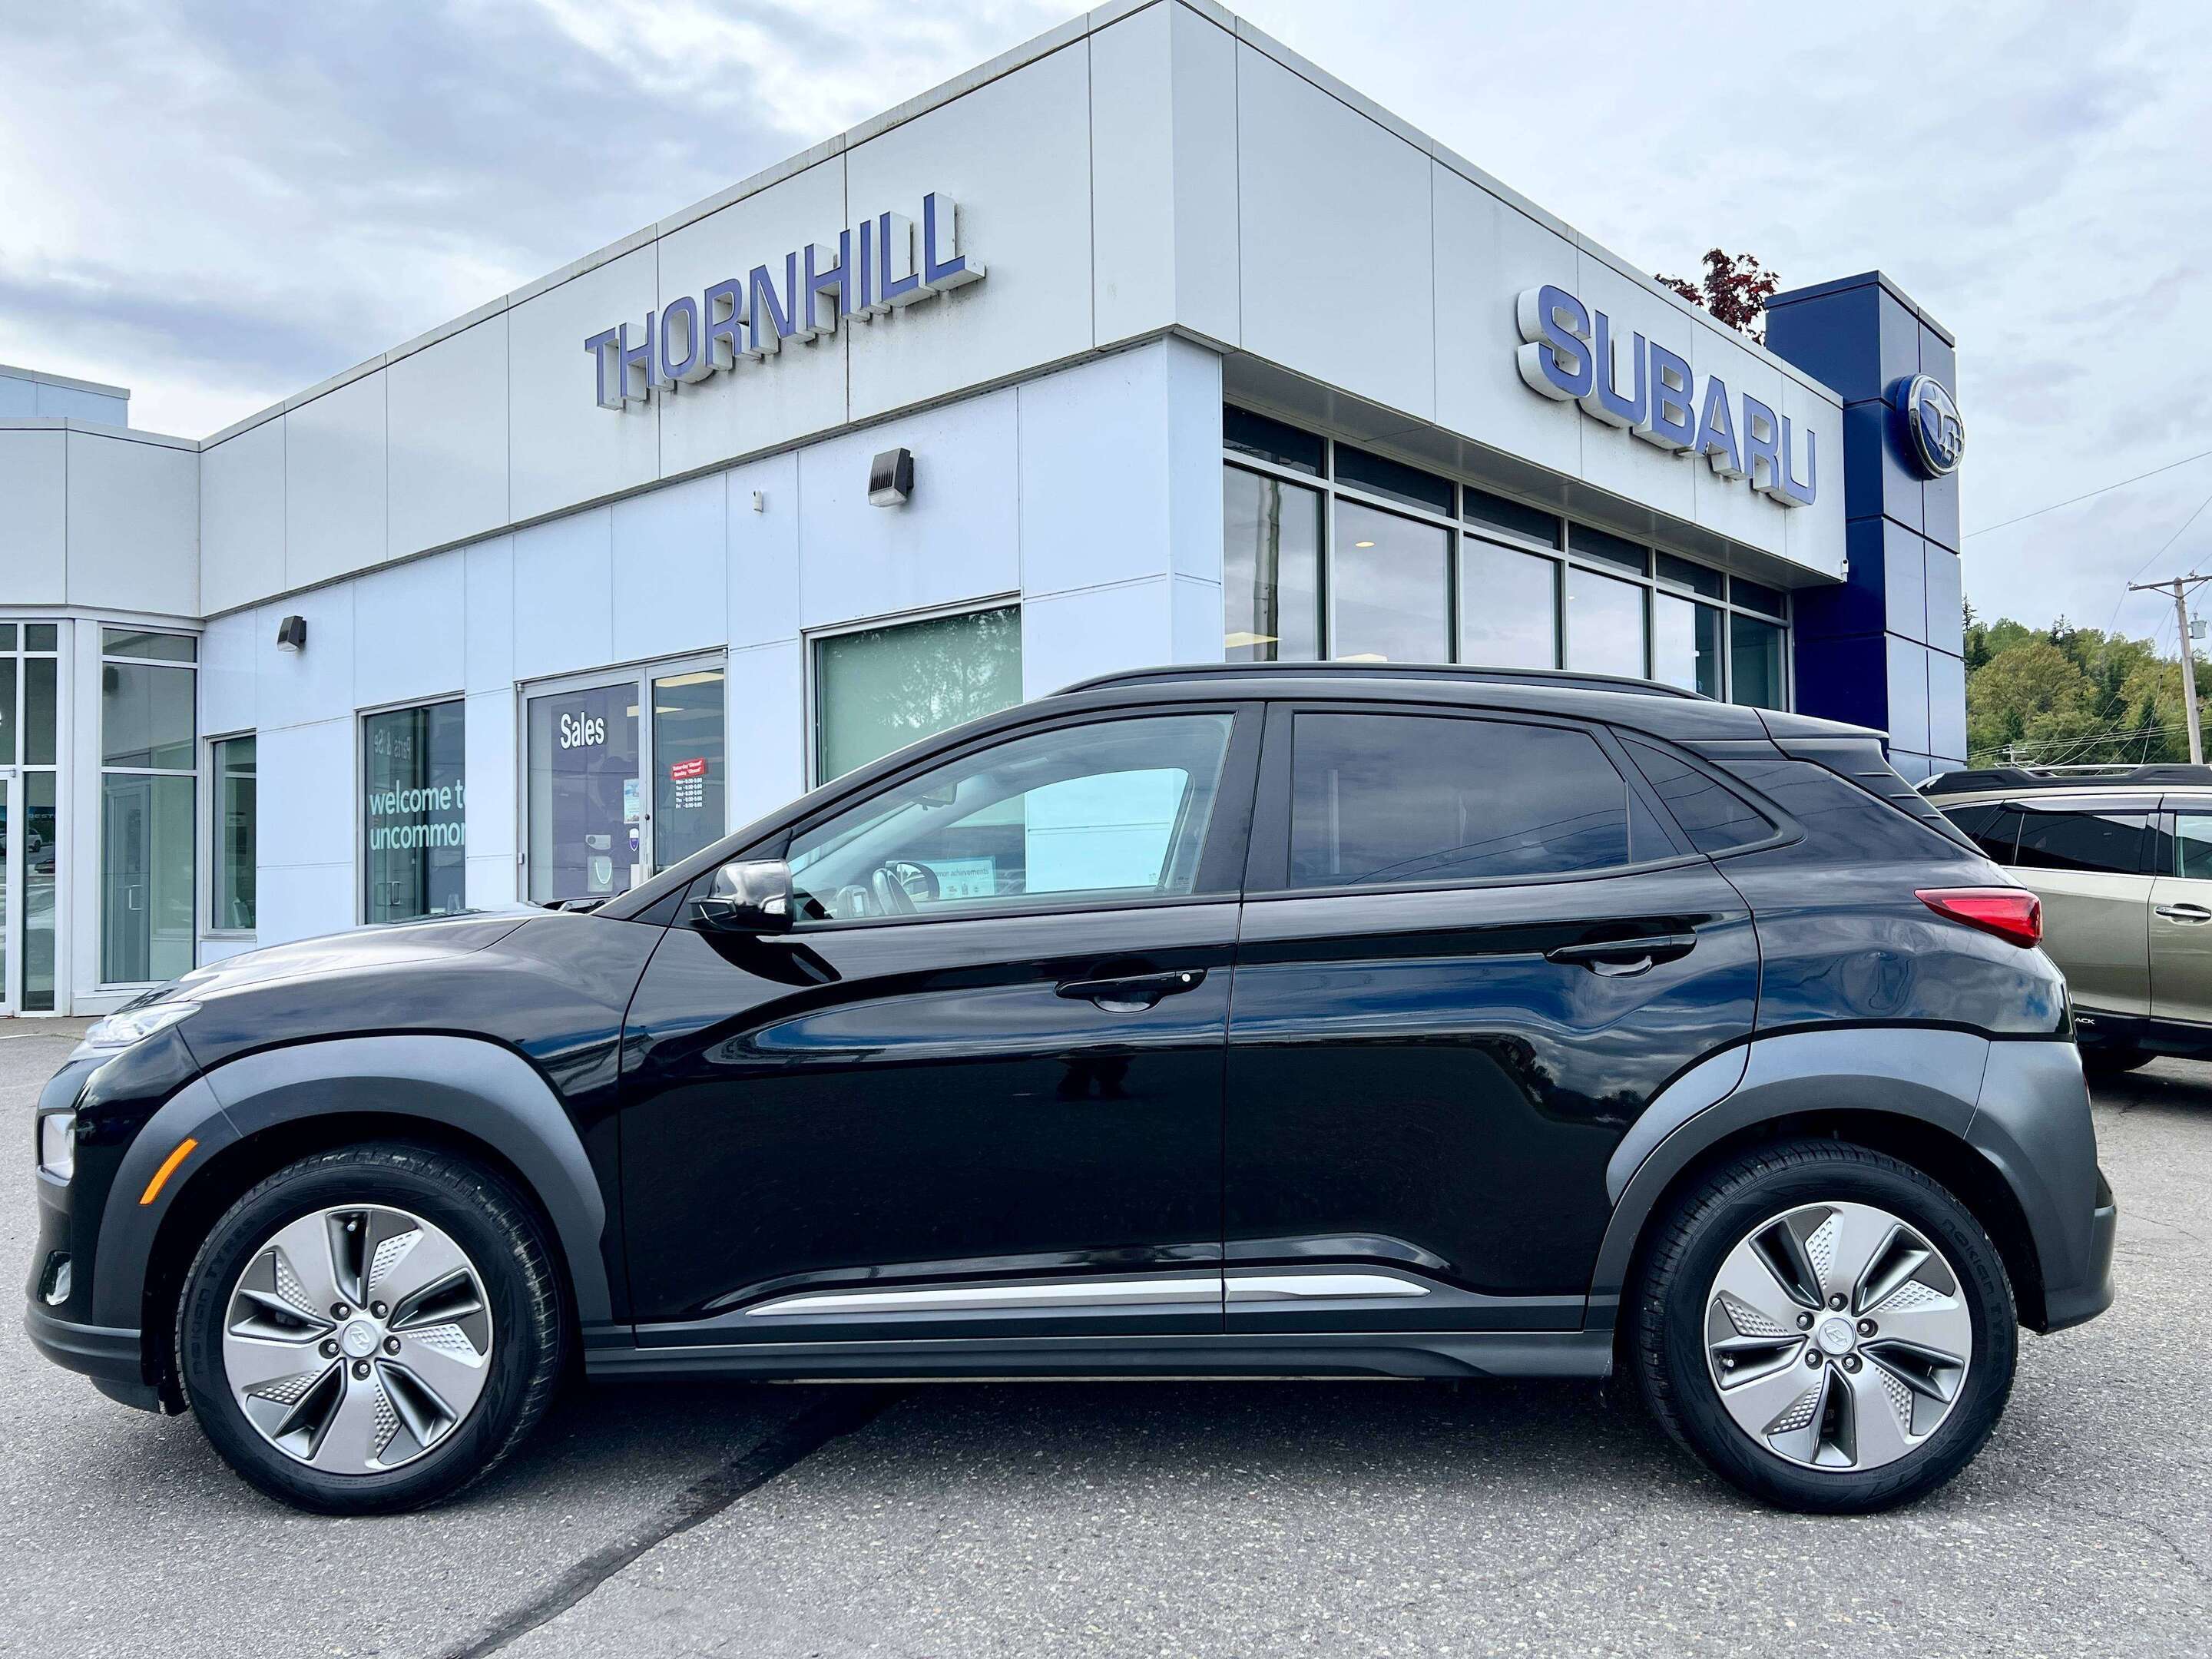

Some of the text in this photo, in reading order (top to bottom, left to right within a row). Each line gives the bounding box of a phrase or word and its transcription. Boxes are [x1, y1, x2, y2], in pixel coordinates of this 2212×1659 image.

[584, 192, 969, 409] THORNHILL
[1525, 284, 1816, 507] SUBARU
[559, 711, 604, 750] Sales
[369, 779, 465, 815] welcome t
